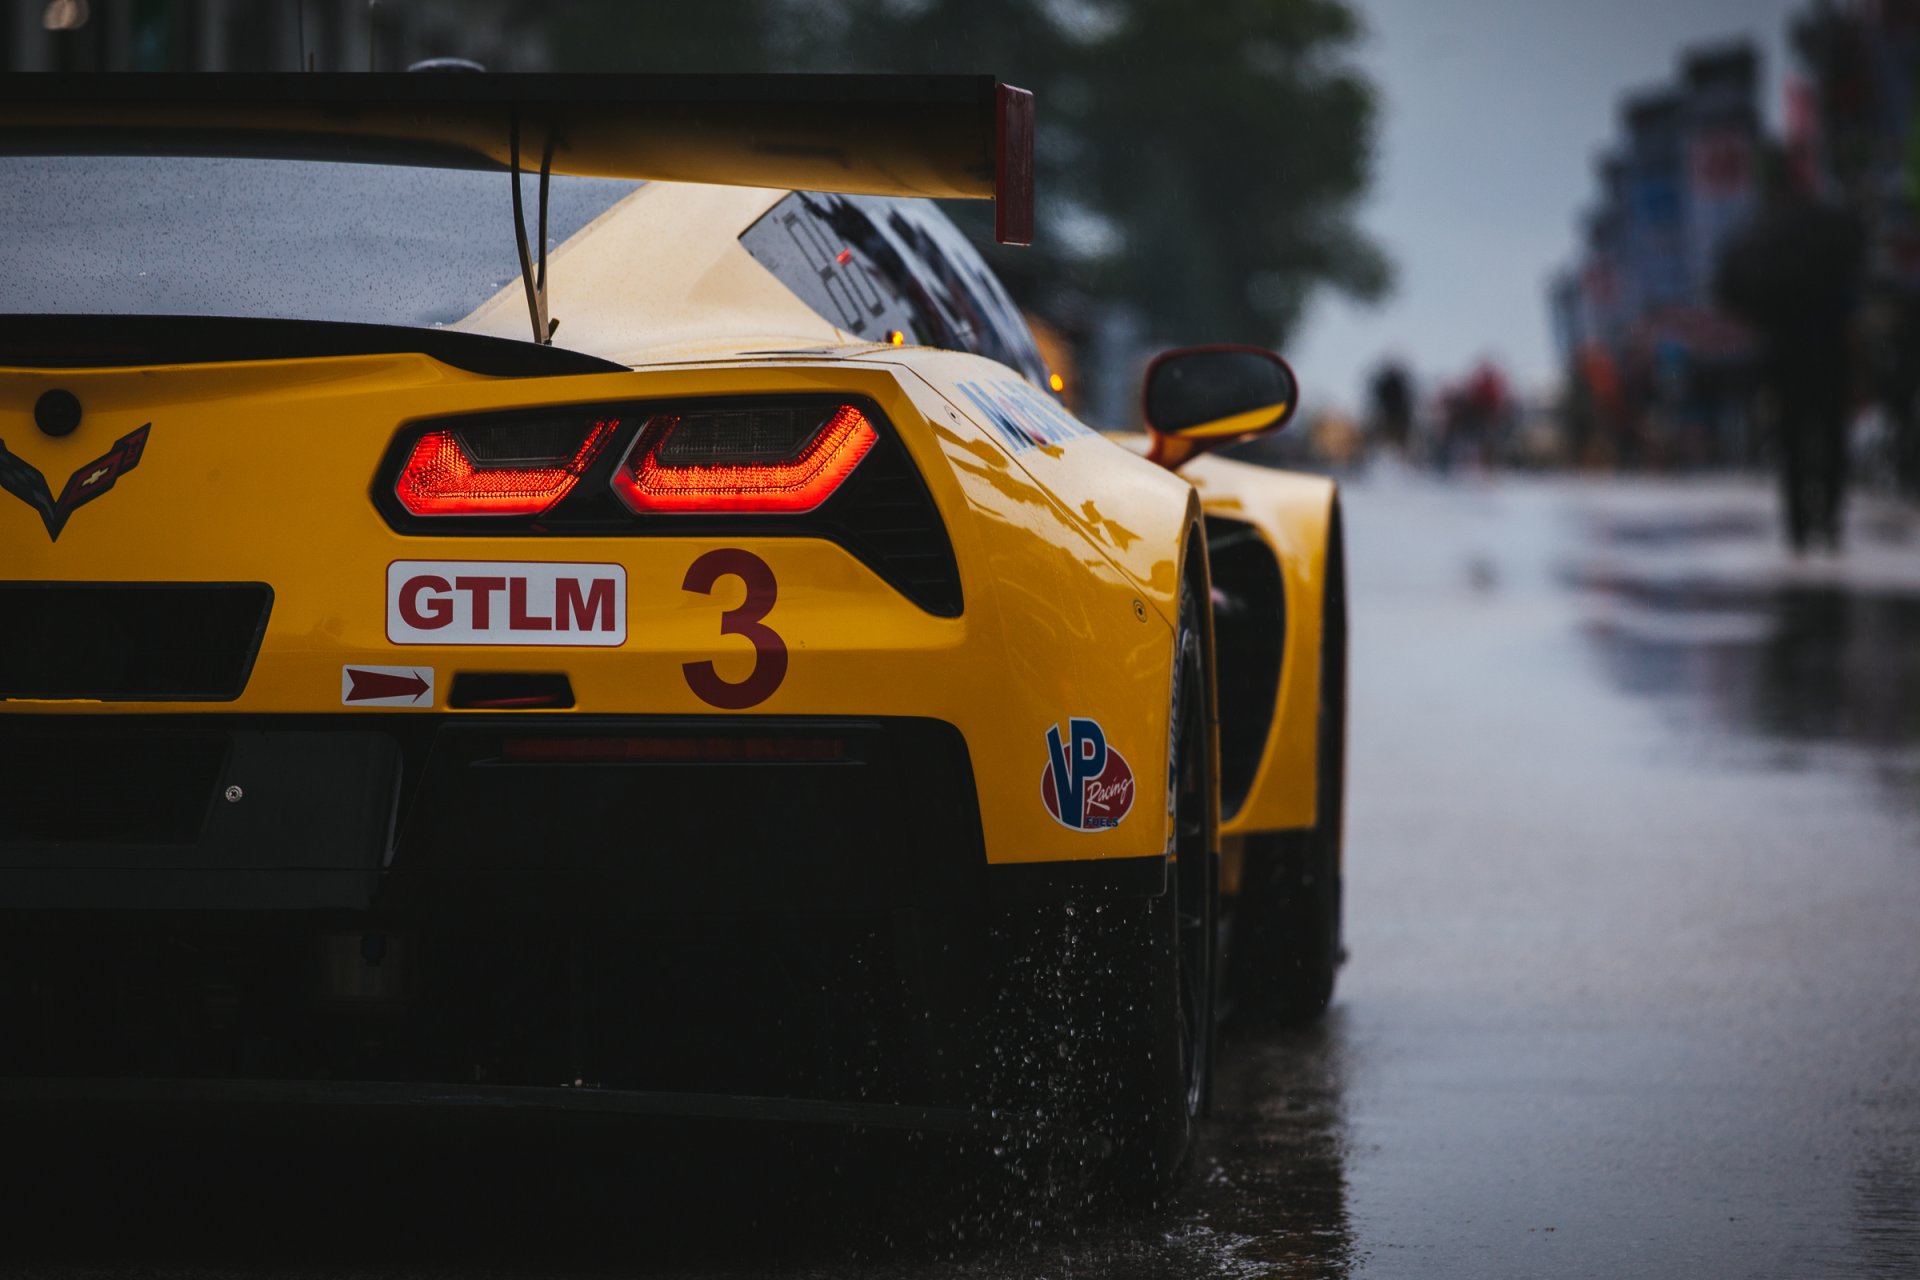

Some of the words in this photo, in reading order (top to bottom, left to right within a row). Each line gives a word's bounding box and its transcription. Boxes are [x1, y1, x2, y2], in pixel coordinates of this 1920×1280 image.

[399, 575, 616, 632] GTLM
[682, 548, 788, 709] 3
[1046, 719, 1107, 829] VP
[1086, 777, 1133, 816] Racing
[1086, 817, 1119, 828] FUELS
